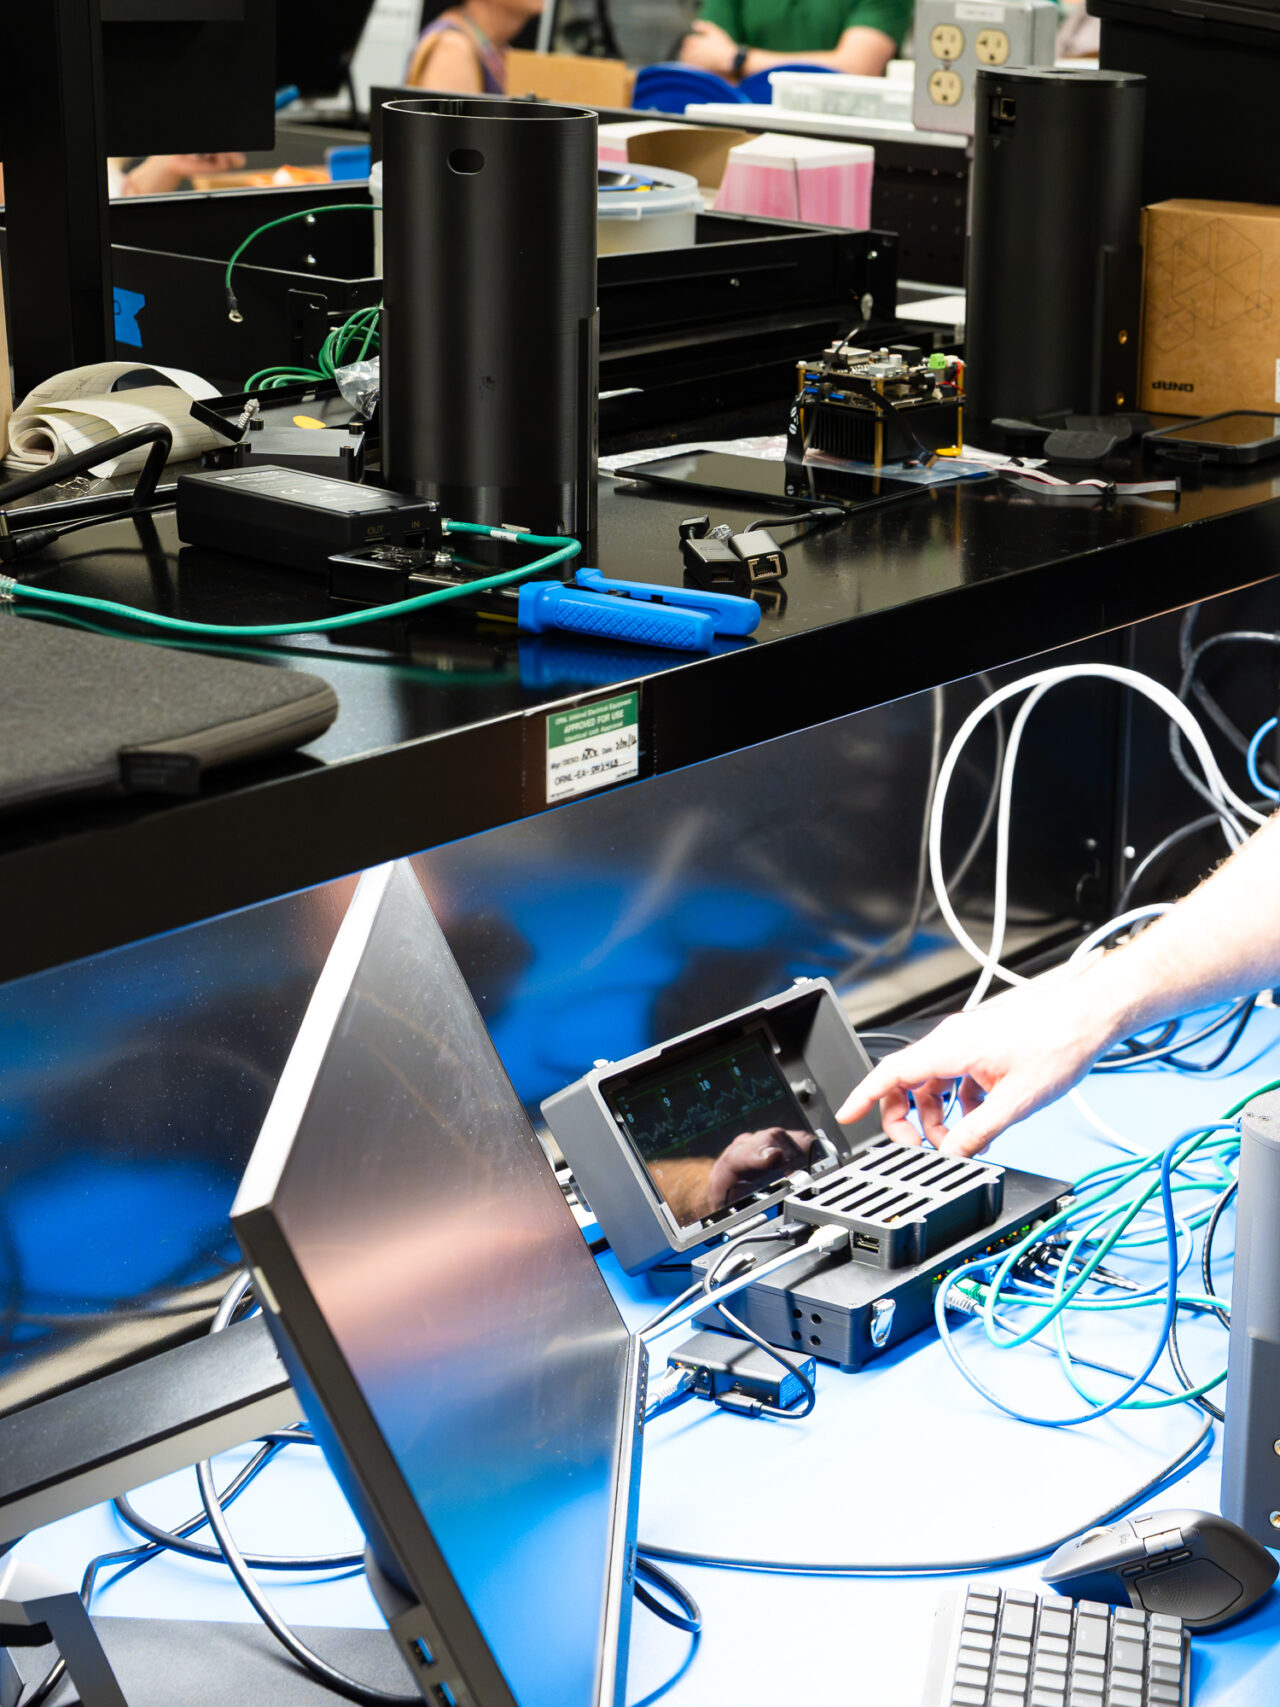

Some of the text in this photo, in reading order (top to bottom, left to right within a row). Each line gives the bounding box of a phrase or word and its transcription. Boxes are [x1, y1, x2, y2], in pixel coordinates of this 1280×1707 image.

[699, 1079, 711, 1092] 10
[663, 1097, 671, 1107] 9
[626, 1113, 634, 1123] 8
